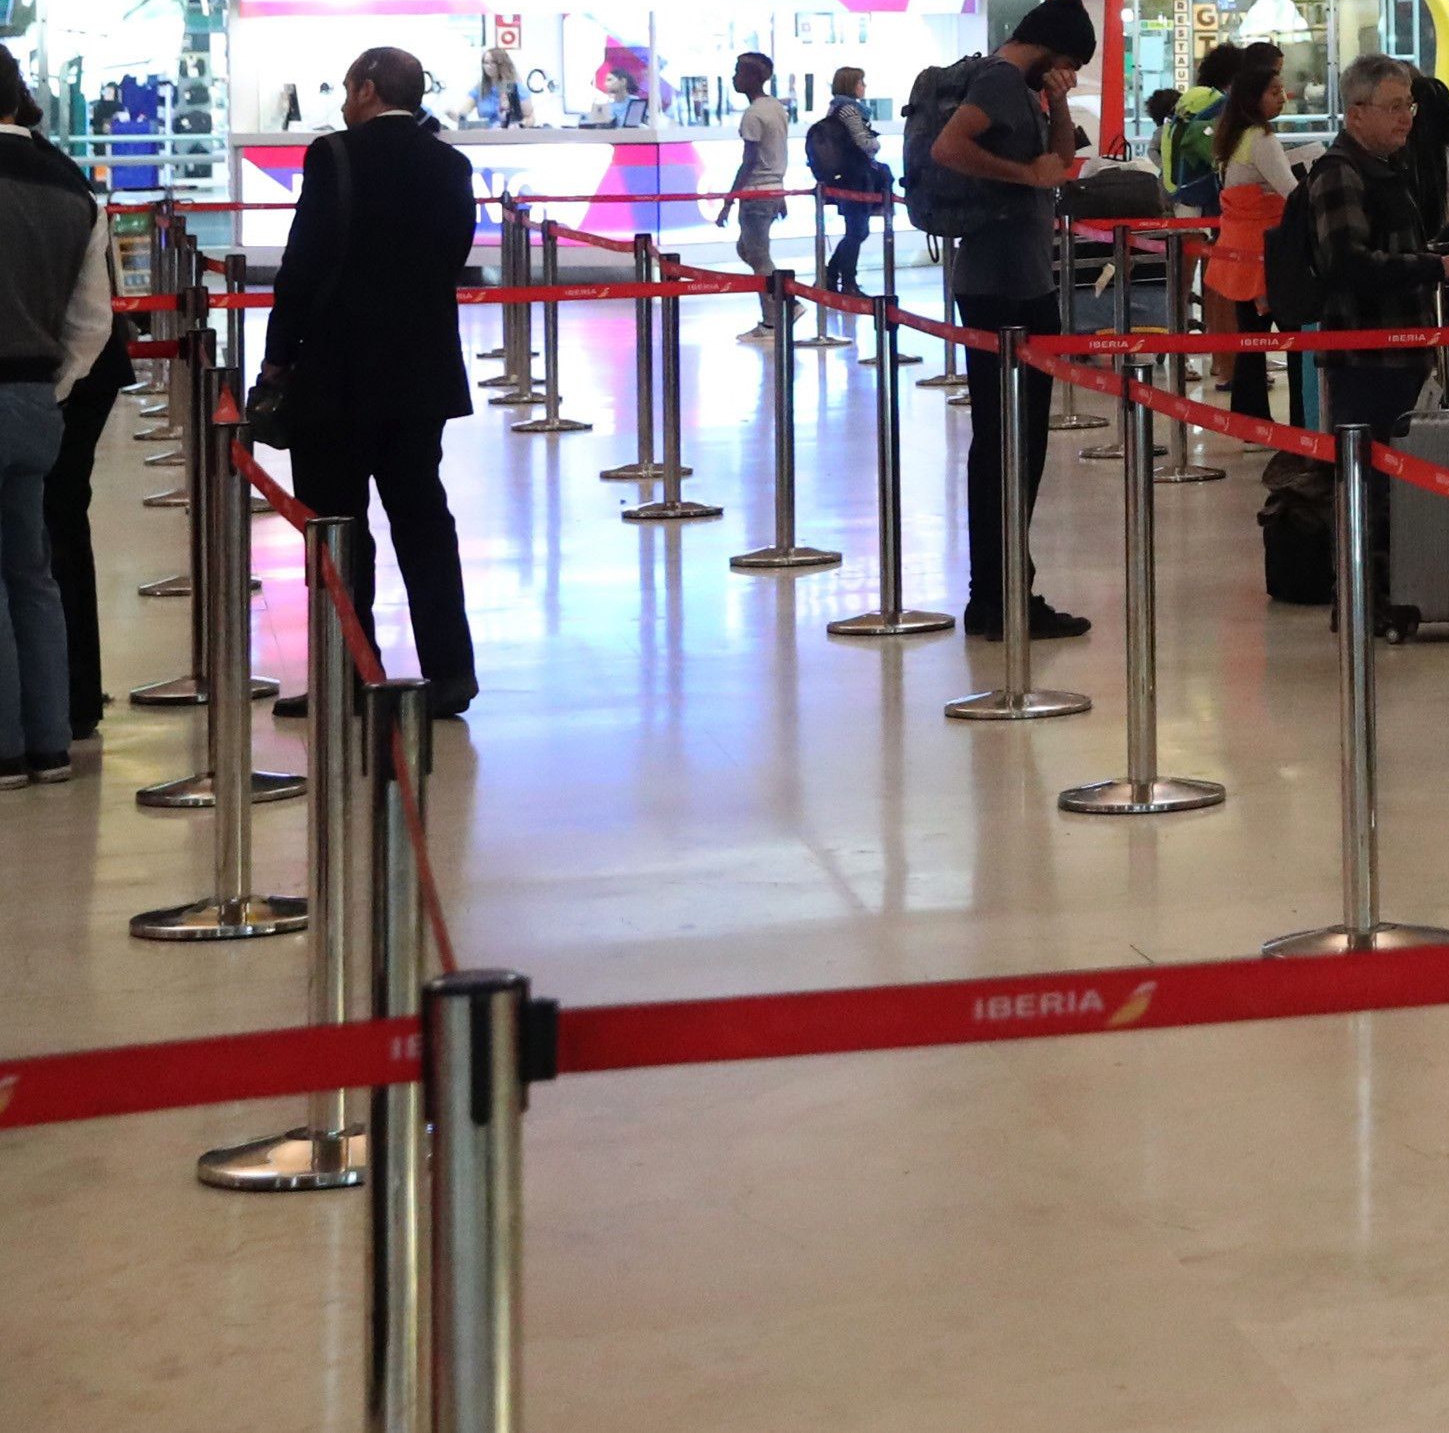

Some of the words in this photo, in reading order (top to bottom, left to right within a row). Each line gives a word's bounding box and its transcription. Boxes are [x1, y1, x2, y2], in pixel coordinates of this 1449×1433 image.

[1240, 338, 1279, 347] IBERIA
[1388, 334, 1426, 343] IBERIA
[1089, 340, 1129, 349] IBERIA
[973, 989, 1104, 1023] IBERIA
